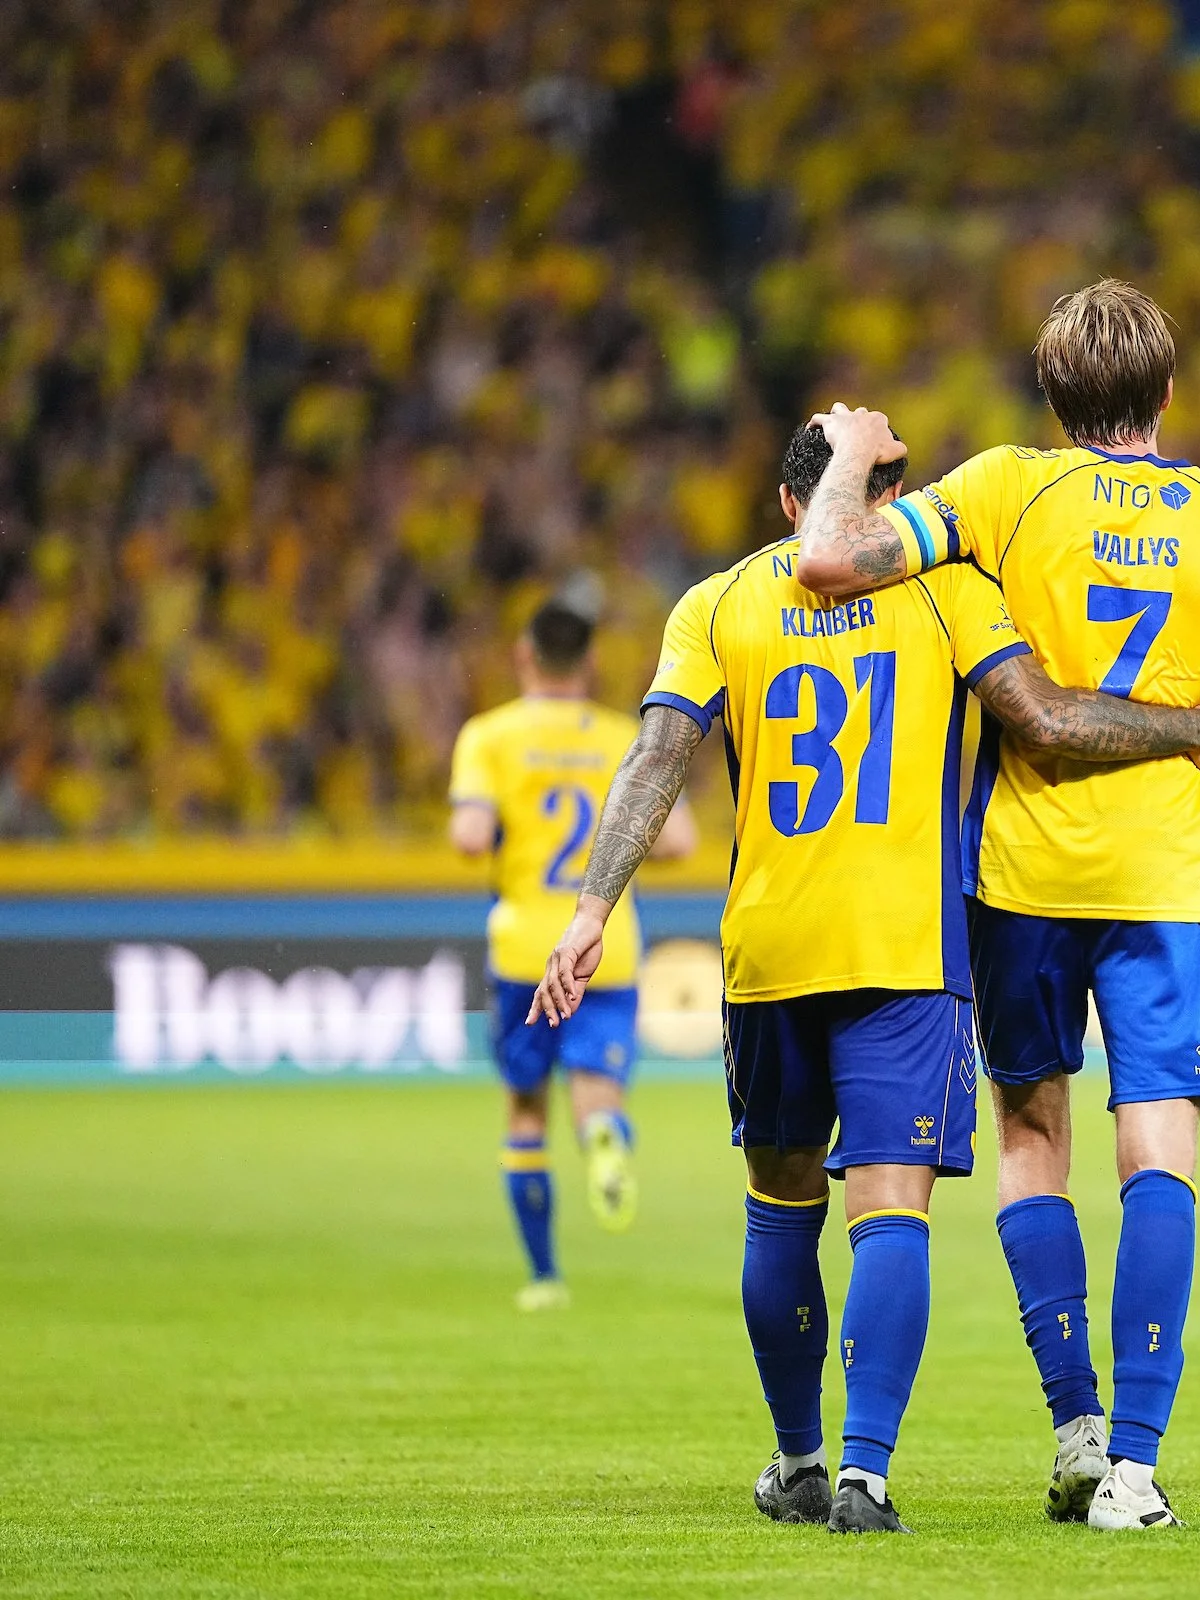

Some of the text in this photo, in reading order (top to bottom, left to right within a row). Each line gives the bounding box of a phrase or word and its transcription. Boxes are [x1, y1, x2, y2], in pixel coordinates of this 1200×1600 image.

[1093, 473, 1151, 509] NTG
[1092, 530, 1180, 568] VALLYS
[781, 597, 876, 638] KLAIBER
[1087, 584, 1173, 699] 7
[765, 650, 897, 838] 31
[910, 1136, 937, 1146] hummel
[796, 1306, 811, 1333] BIF
[1056, 1312, 1073, 1341] BIF
[843, 1338, 854, 1369] BIF
[1147, 1323, 1162, 1354] BIF
